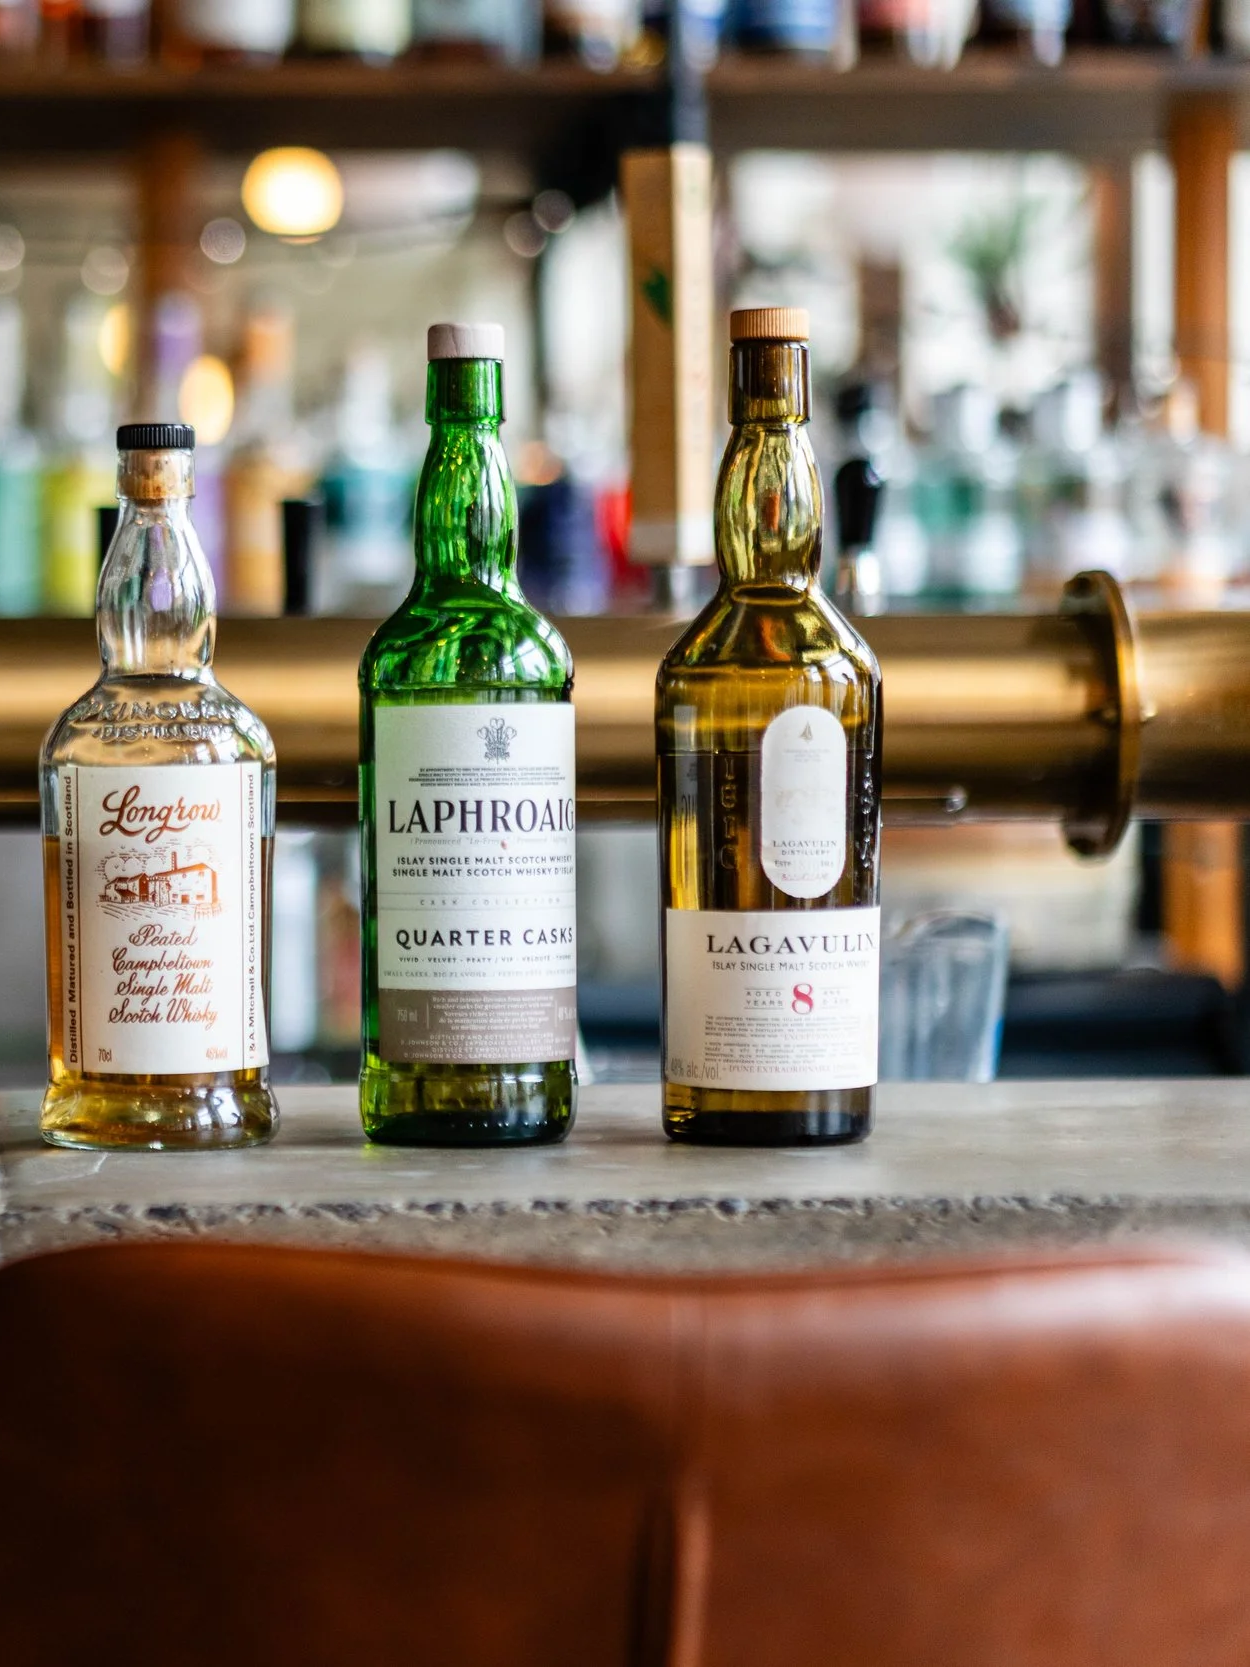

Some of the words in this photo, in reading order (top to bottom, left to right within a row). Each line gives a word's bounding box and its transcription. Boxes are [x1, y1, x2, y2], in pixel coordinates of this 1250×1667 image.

[64, 776, 73, 837] Scotland
[99, 785, 221, 844] Longrow
[389, 798, 574, 834] LAPHROAIG
[65, 842, 73, 855] in
[772, 840, 837, 848] LAGAVULIN
[392, 868, 428, 877] SINGLE
[432, 868, 462, 877] MALT
[466, 868, 512, 877] SCOTCH
[516, 867, 551, 876] WHISKY
[397, 856, 425, 865] ISLAY
[429, 856, 470, 866] SINGLE
[475, 856, 504, 865] MALT
[508, 856, 547, 865] SCOTCH
[66, 859, 74, 909] Bottled
[67, 914, 75, 940] and
[129, 923, 198, 947] Peated
[396, 929, 512, 950] QUARTER
[523, 927, 573, 945] CASKS
[707, 934, 875, 955] LAGAVULIN
[67, 944, 76, 1003] Matured
[112, 947, 213, 979] Campbeltown
[712, 961, 736, 971] ISLAY
[740, 961, 775, 971] SINGLE
[779, 961, 805, 971] MALT
[808, 961, 844, 971] SCOTCH
[115, 972, 169, 1006] Single
[172, 973, 213, 996] Malt
[791, 983, 815, 1015] 8
[108, 998, 163, 1023] Scotch
[166, 998, 218, 1030] Whisky
[69, 1009, 78, 1064] Distilled
[98, 1048, 112, 1062] 70cl
